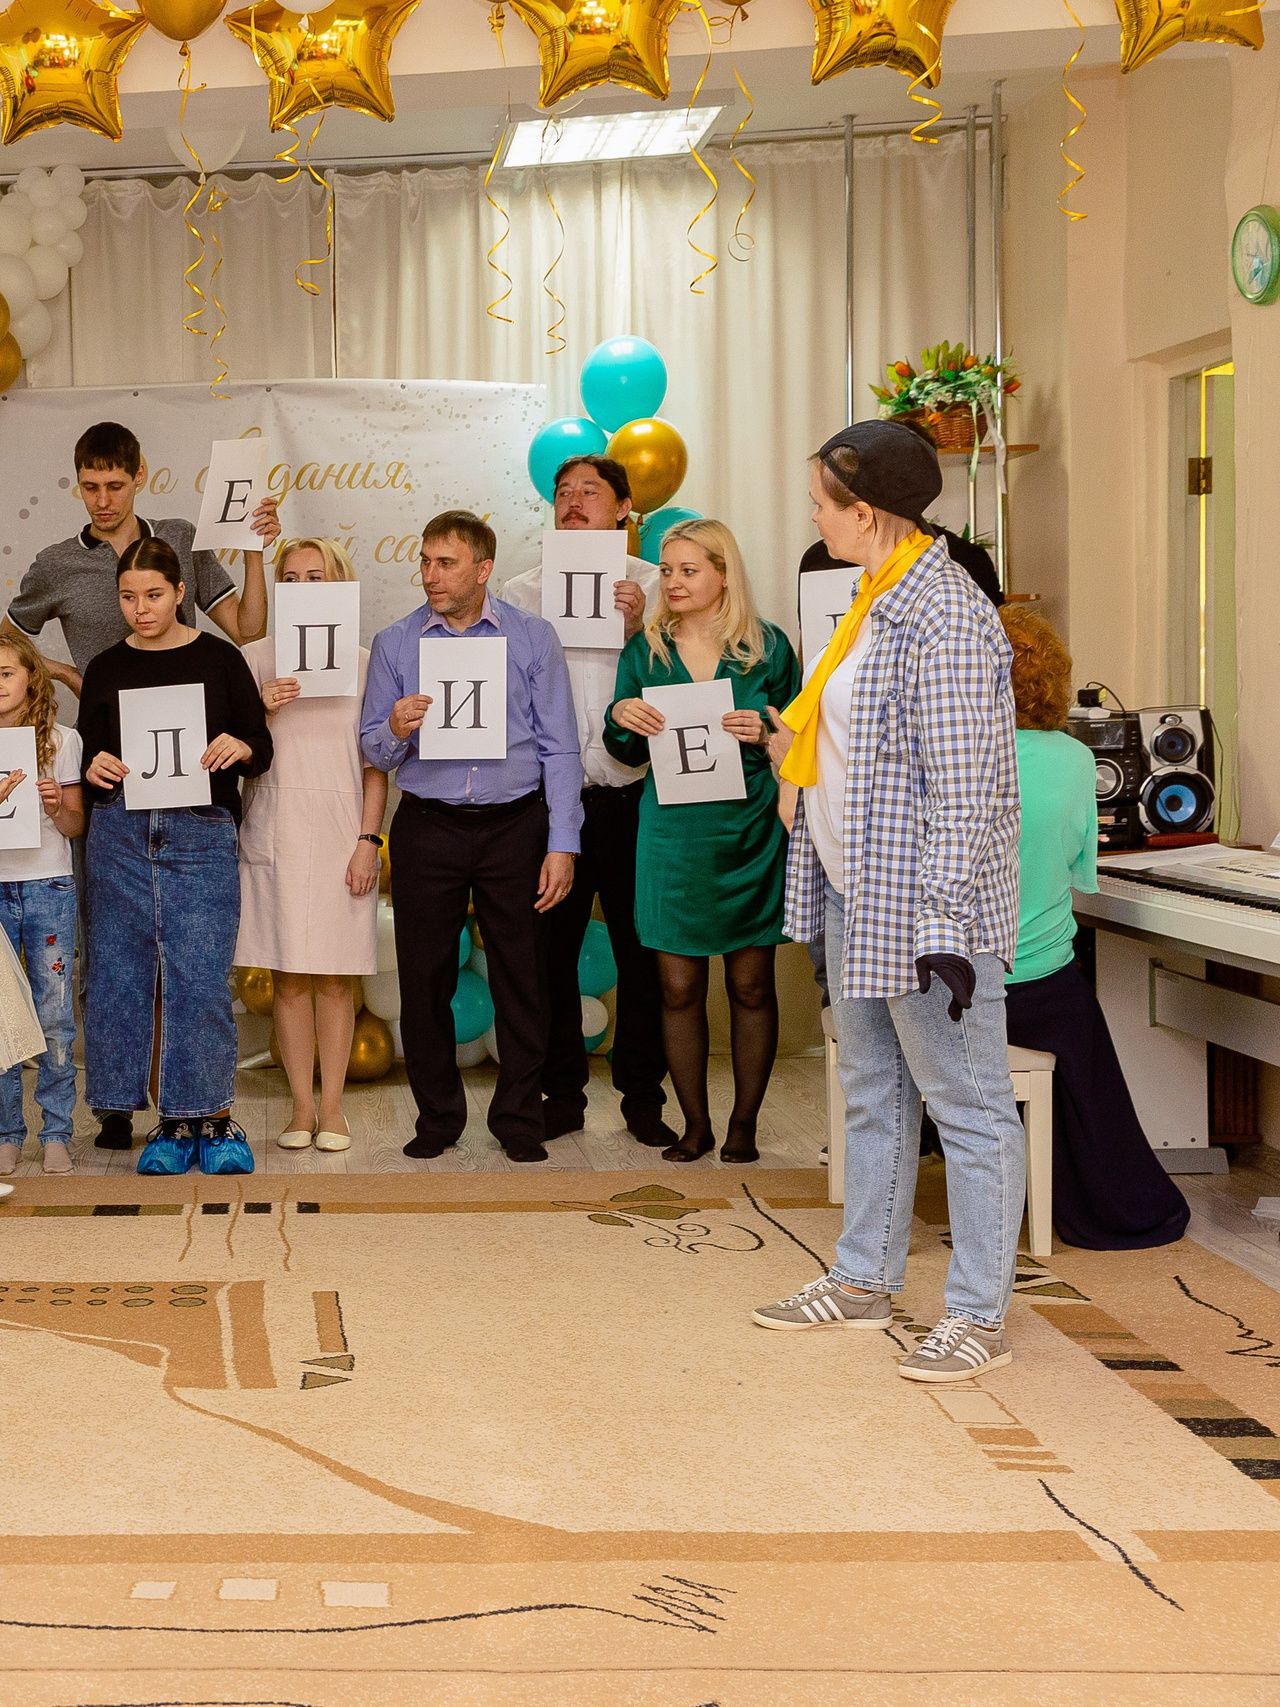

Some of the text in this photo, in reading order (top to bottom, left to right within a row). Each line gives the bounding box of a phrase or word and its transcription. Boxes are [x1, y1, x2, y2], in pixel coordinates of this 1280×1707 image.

[214, 479, 253, 524] Е
[558, 571, 608, 620] П
[292, 623, 342, 673] П
[437, 680, 488, 730] И
[141, 727, 189, 780] Л
[668, 724, 718, 776] Е
